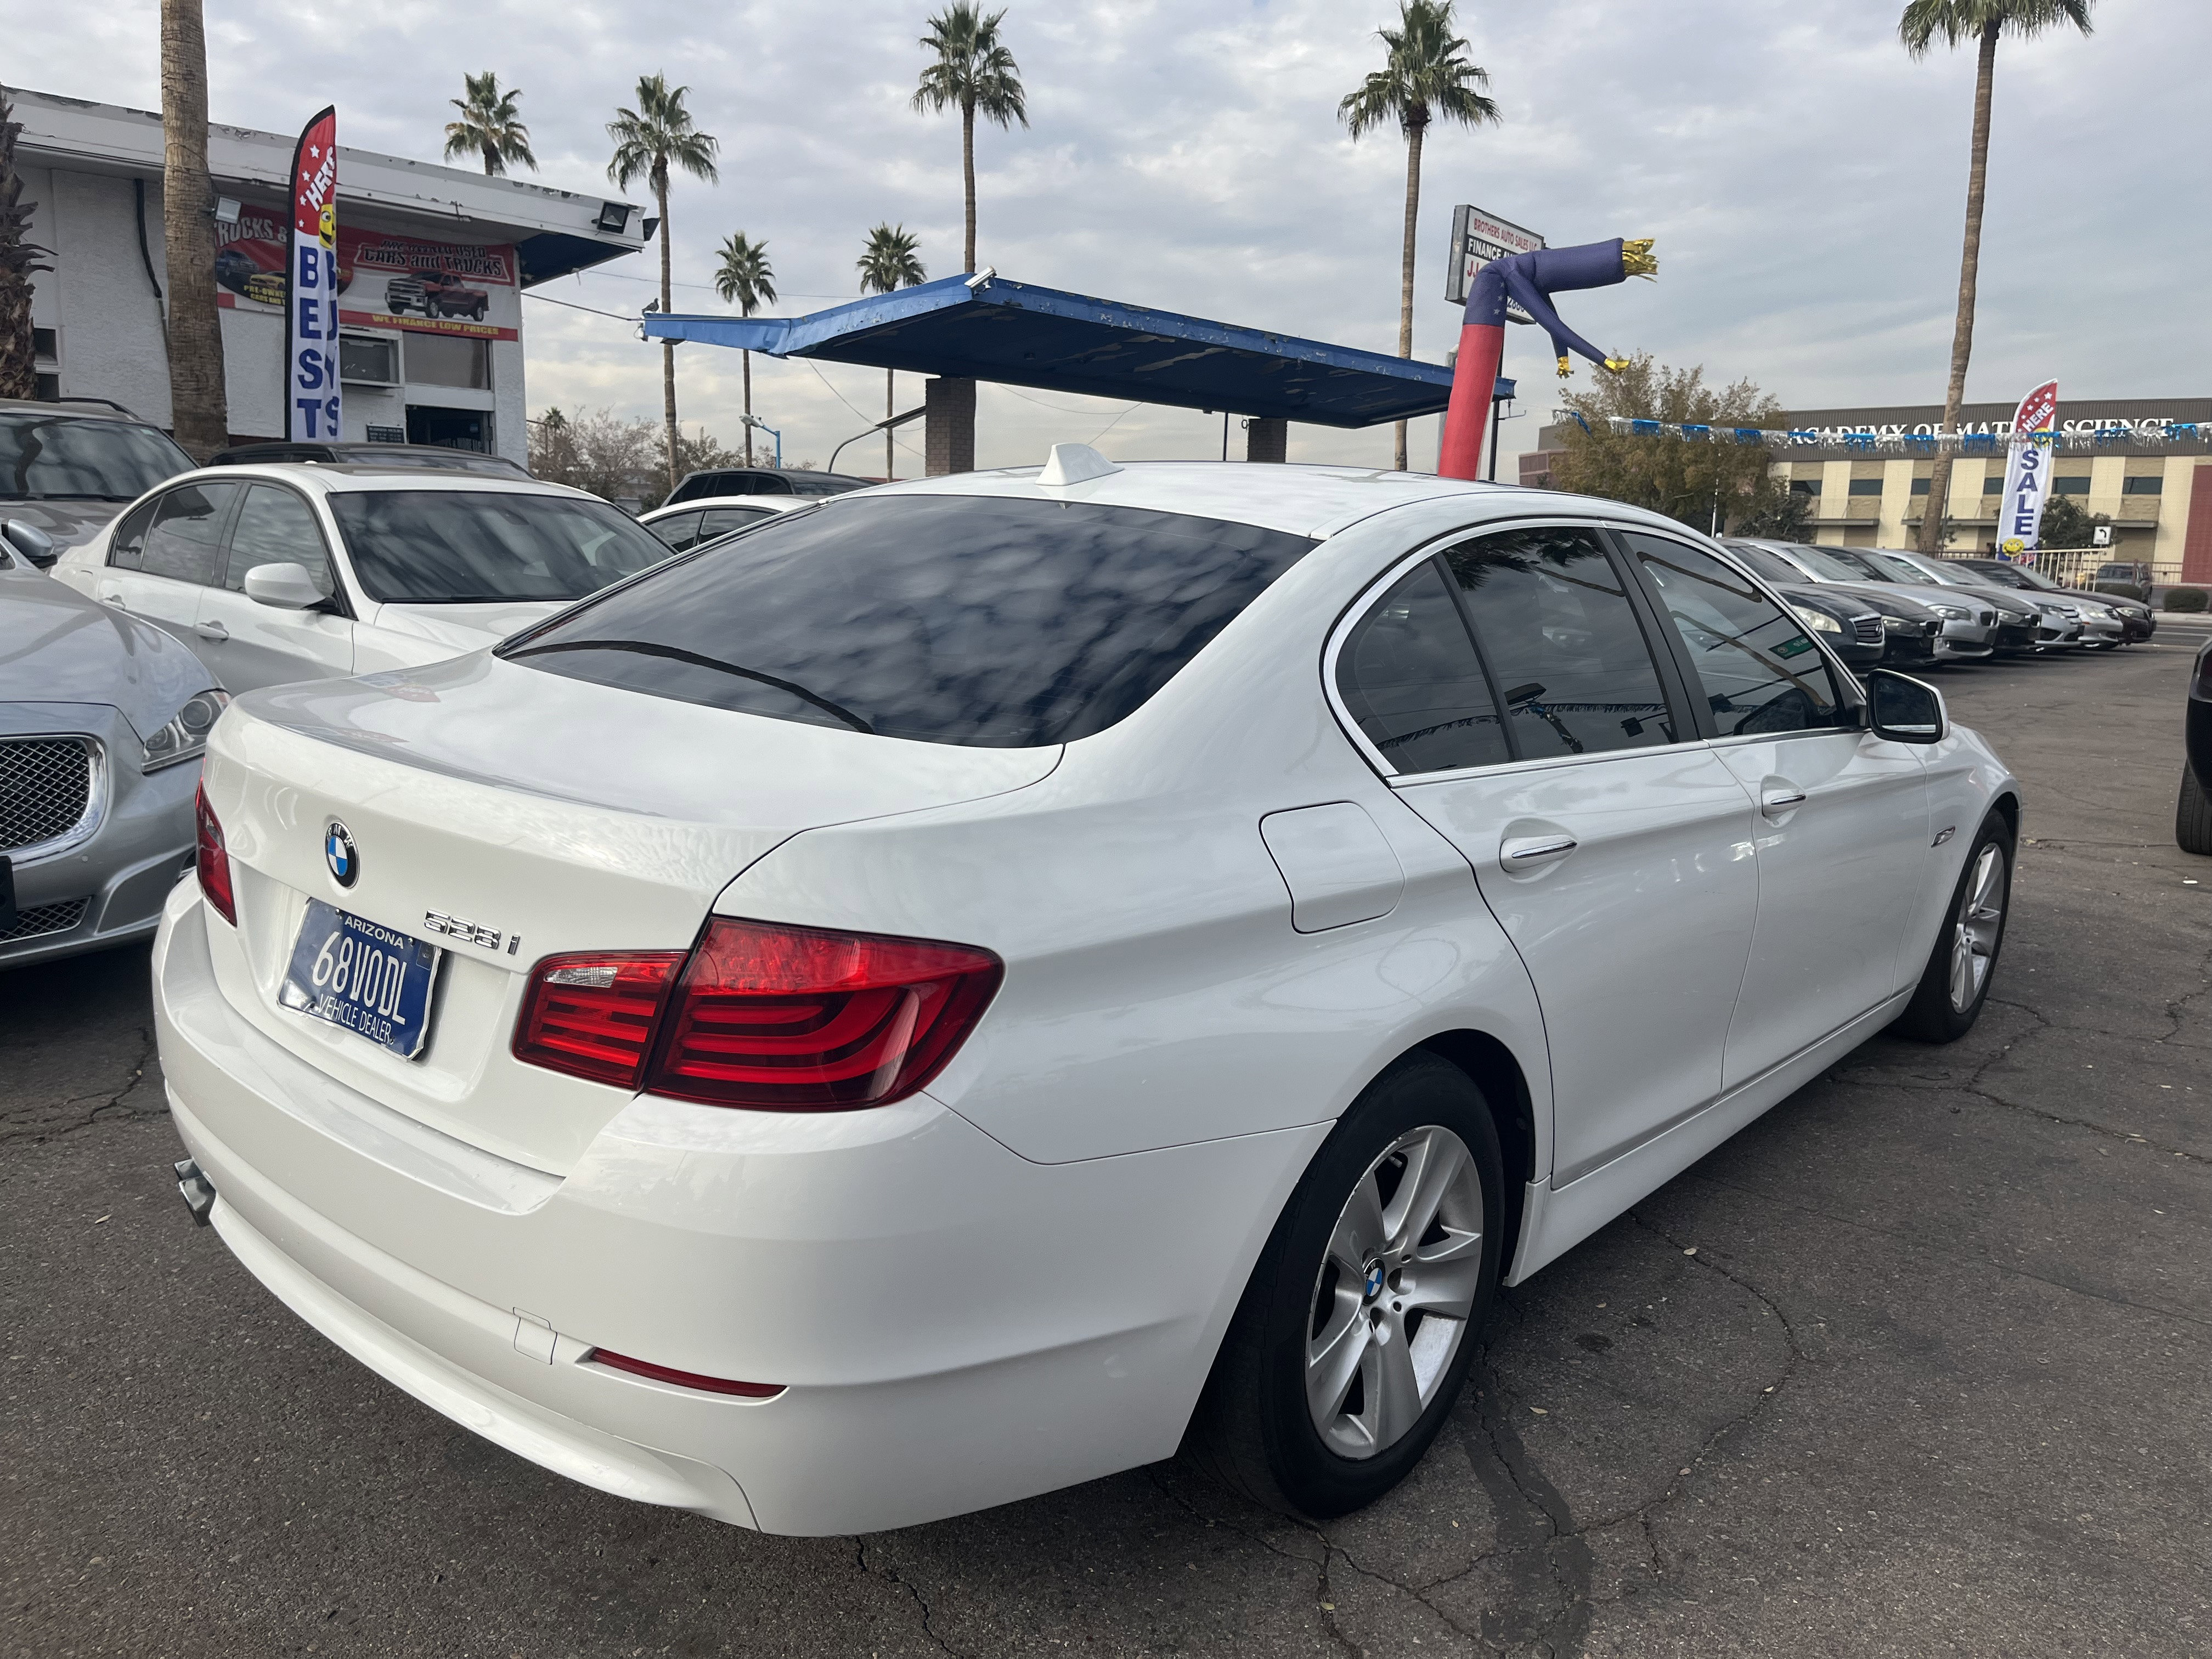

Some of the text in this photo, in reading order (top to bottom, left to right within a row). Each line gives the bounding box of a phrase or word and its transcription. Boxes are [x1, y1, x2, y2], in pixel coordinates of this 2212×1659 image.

[213, 217, 273, 247] RUCKS
[1474, 218, 1500, 239] BROTHERS
[1500, 229, 1515, 245] AUTO
[1515, 235, 1528, 251] SALES
[364, 247, 502, 275] CARS and TRUCKS
[455, 245, 486, 257] USED
[1468, 238, 1502, 261] FINANCE
[372, 314, 499, 335] WE FINANCE LOW PRICES
[297, 245, 324, 438] BEST
[1791, 424, 1907, 444] ACADEMY
[1914, 422, 1944, 441] OF
[2062, 417, 2174, 437] SCIENCE
[2022, 401, 2054, 433] HERE
[2013, 449, 2039, 535] SALE
[344, 915, 404, 950] ARIZONA
[318, 994, 392, 1044] VEHICLE DEALER
